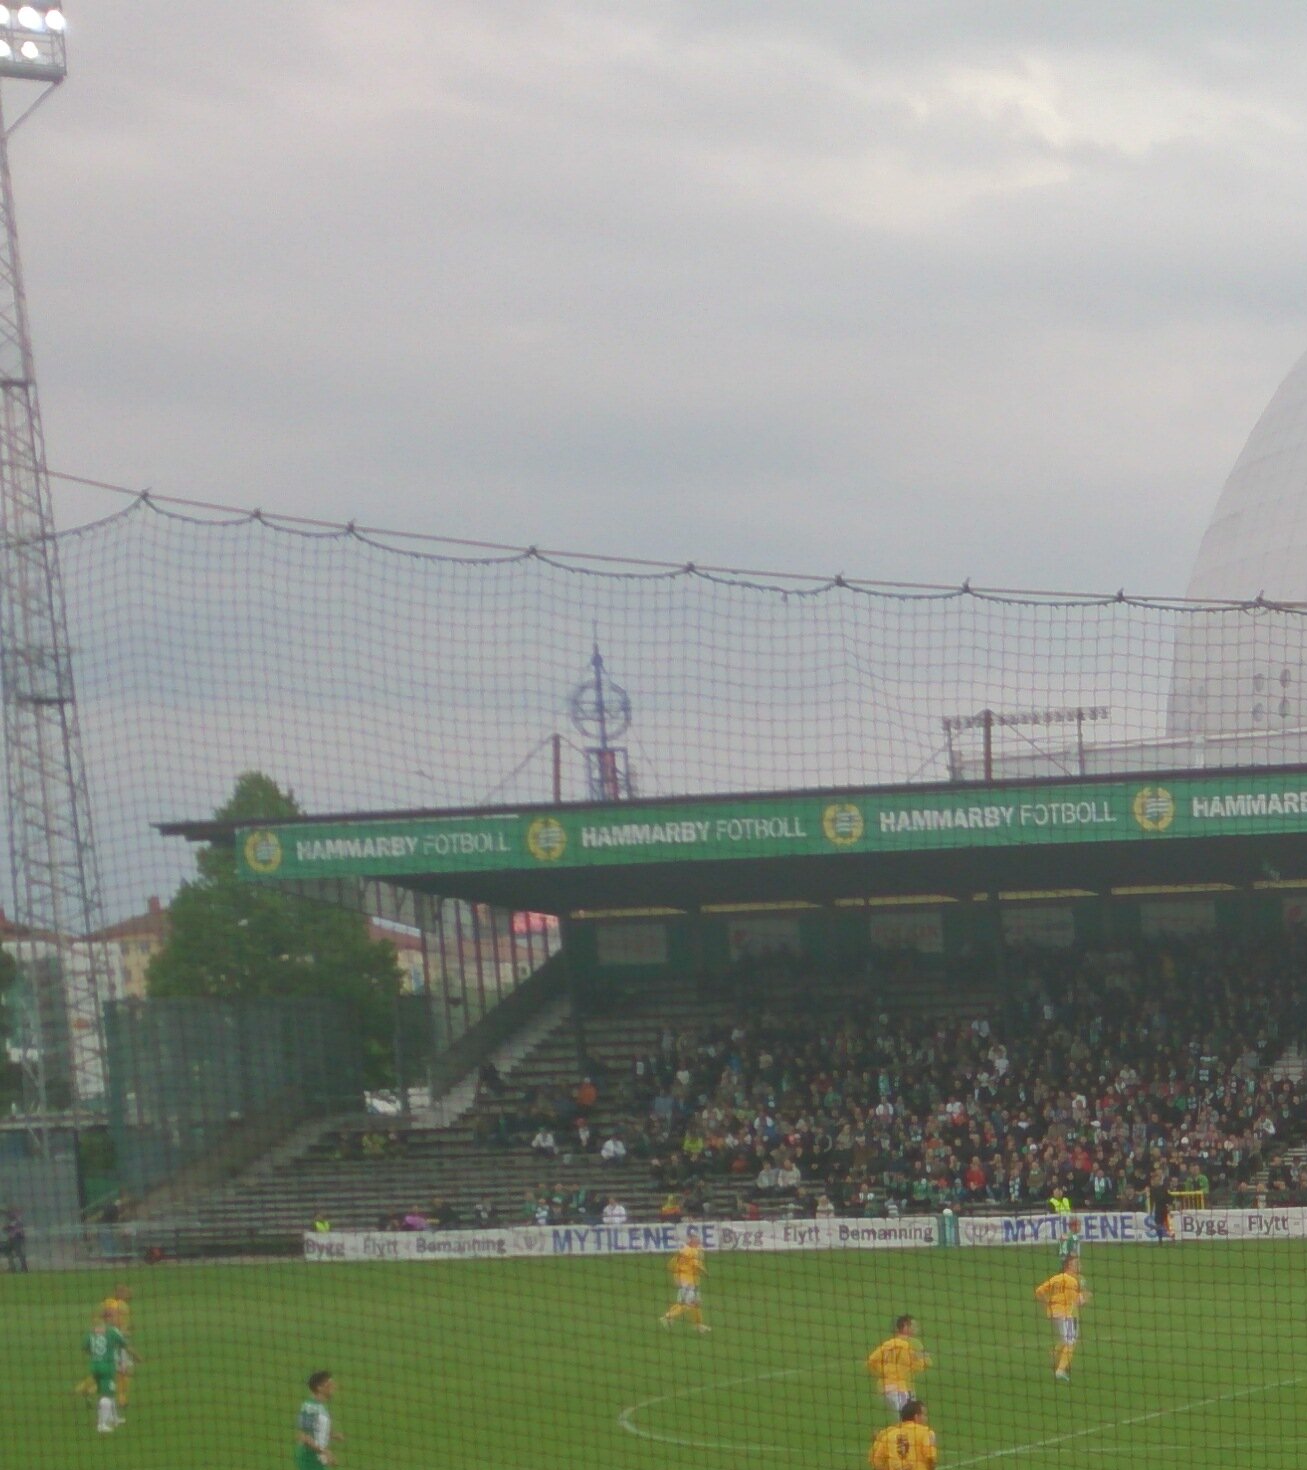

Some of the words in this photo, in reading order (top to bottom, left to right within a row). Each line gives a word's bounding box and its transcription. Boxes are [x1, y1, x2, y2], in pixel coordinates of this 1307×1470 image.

[880, 805, 1014, 833] HAMMARBY
[1020, 800, 1117, 827] FOTBOLL
[297, 837, 418, 862] HAMMARBY
[423, 830, 510, 856] FOTBOLL
[582, 822, 710, 848] HAMMARBY
[715, 817, 807, 842] FOTBOLL
[721, 1229, 764, 1250] Bygg
[783, 1226, 821, 1245] Flytt
[838, 1223, 934, 1243] Bemanning
[1182, 1213, 1229, 1235] Bygg
[1247, 1213, 1289, 1232] Flytt
[305, 1238, 346, 1257] Bygg
[363, 1236, 400, 1257] Flytt
[415, 1235, 505, 1257] Bemanning
